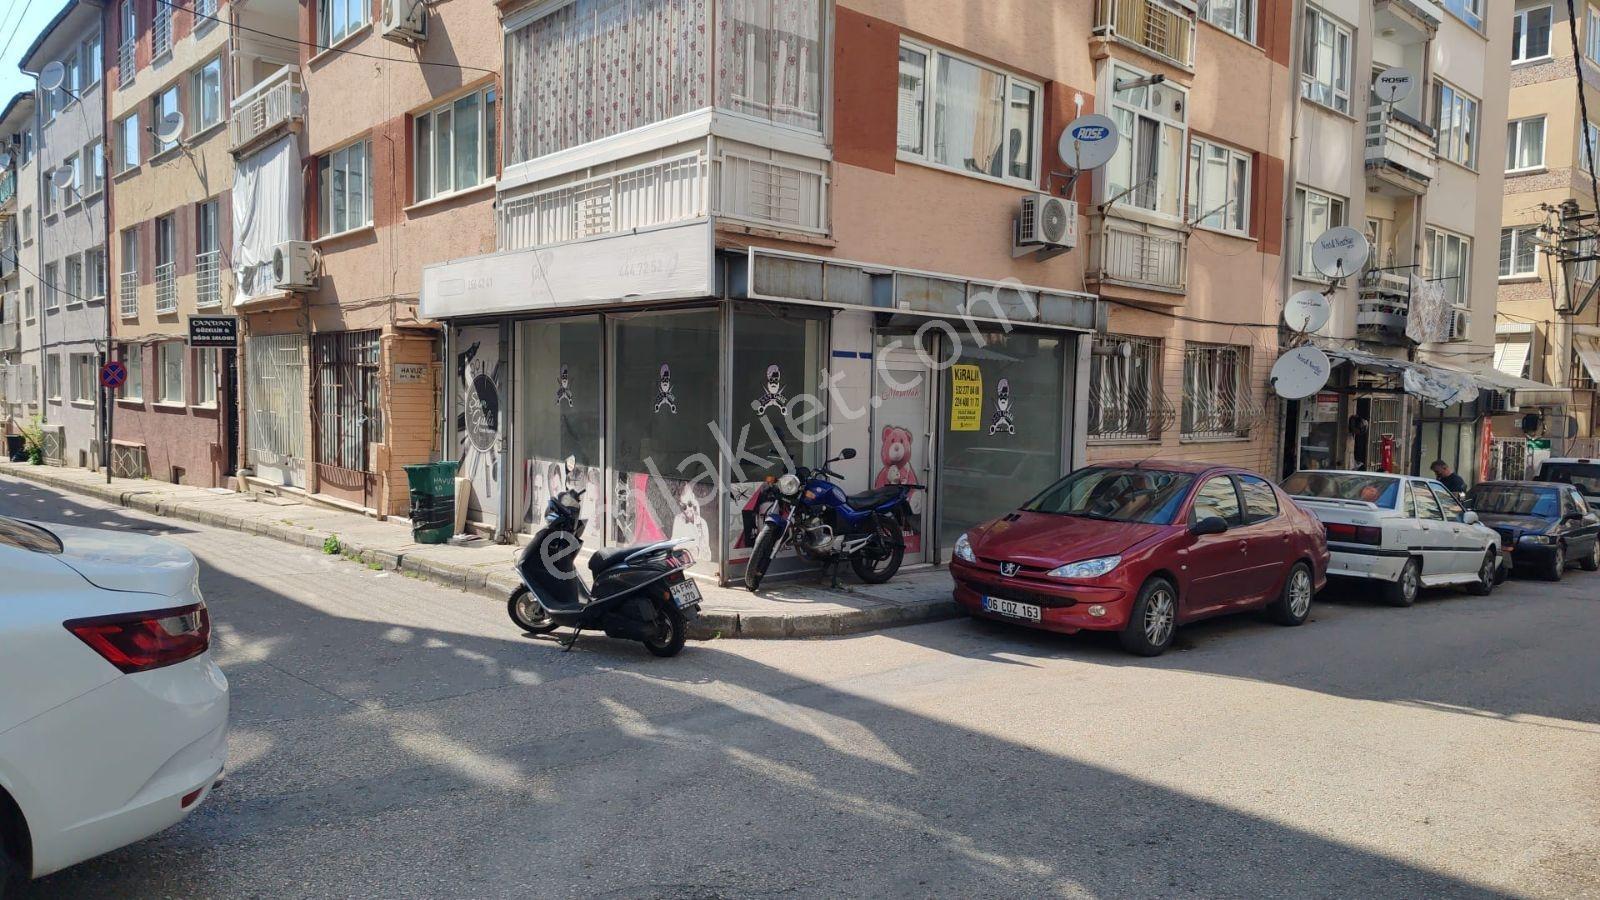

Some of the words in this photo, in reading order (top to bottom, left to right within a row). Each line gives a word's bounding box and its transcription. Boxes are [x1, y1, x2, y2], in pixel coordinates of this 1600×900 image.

[1381, 76, 1409, 84] ROSE
[1077, 127, 1104, 139] ROSE
[401, 367, 423, 375] HAVUZ
[987, 598, 998, 610] 06
[1022, 605, 1039, 618] 163
